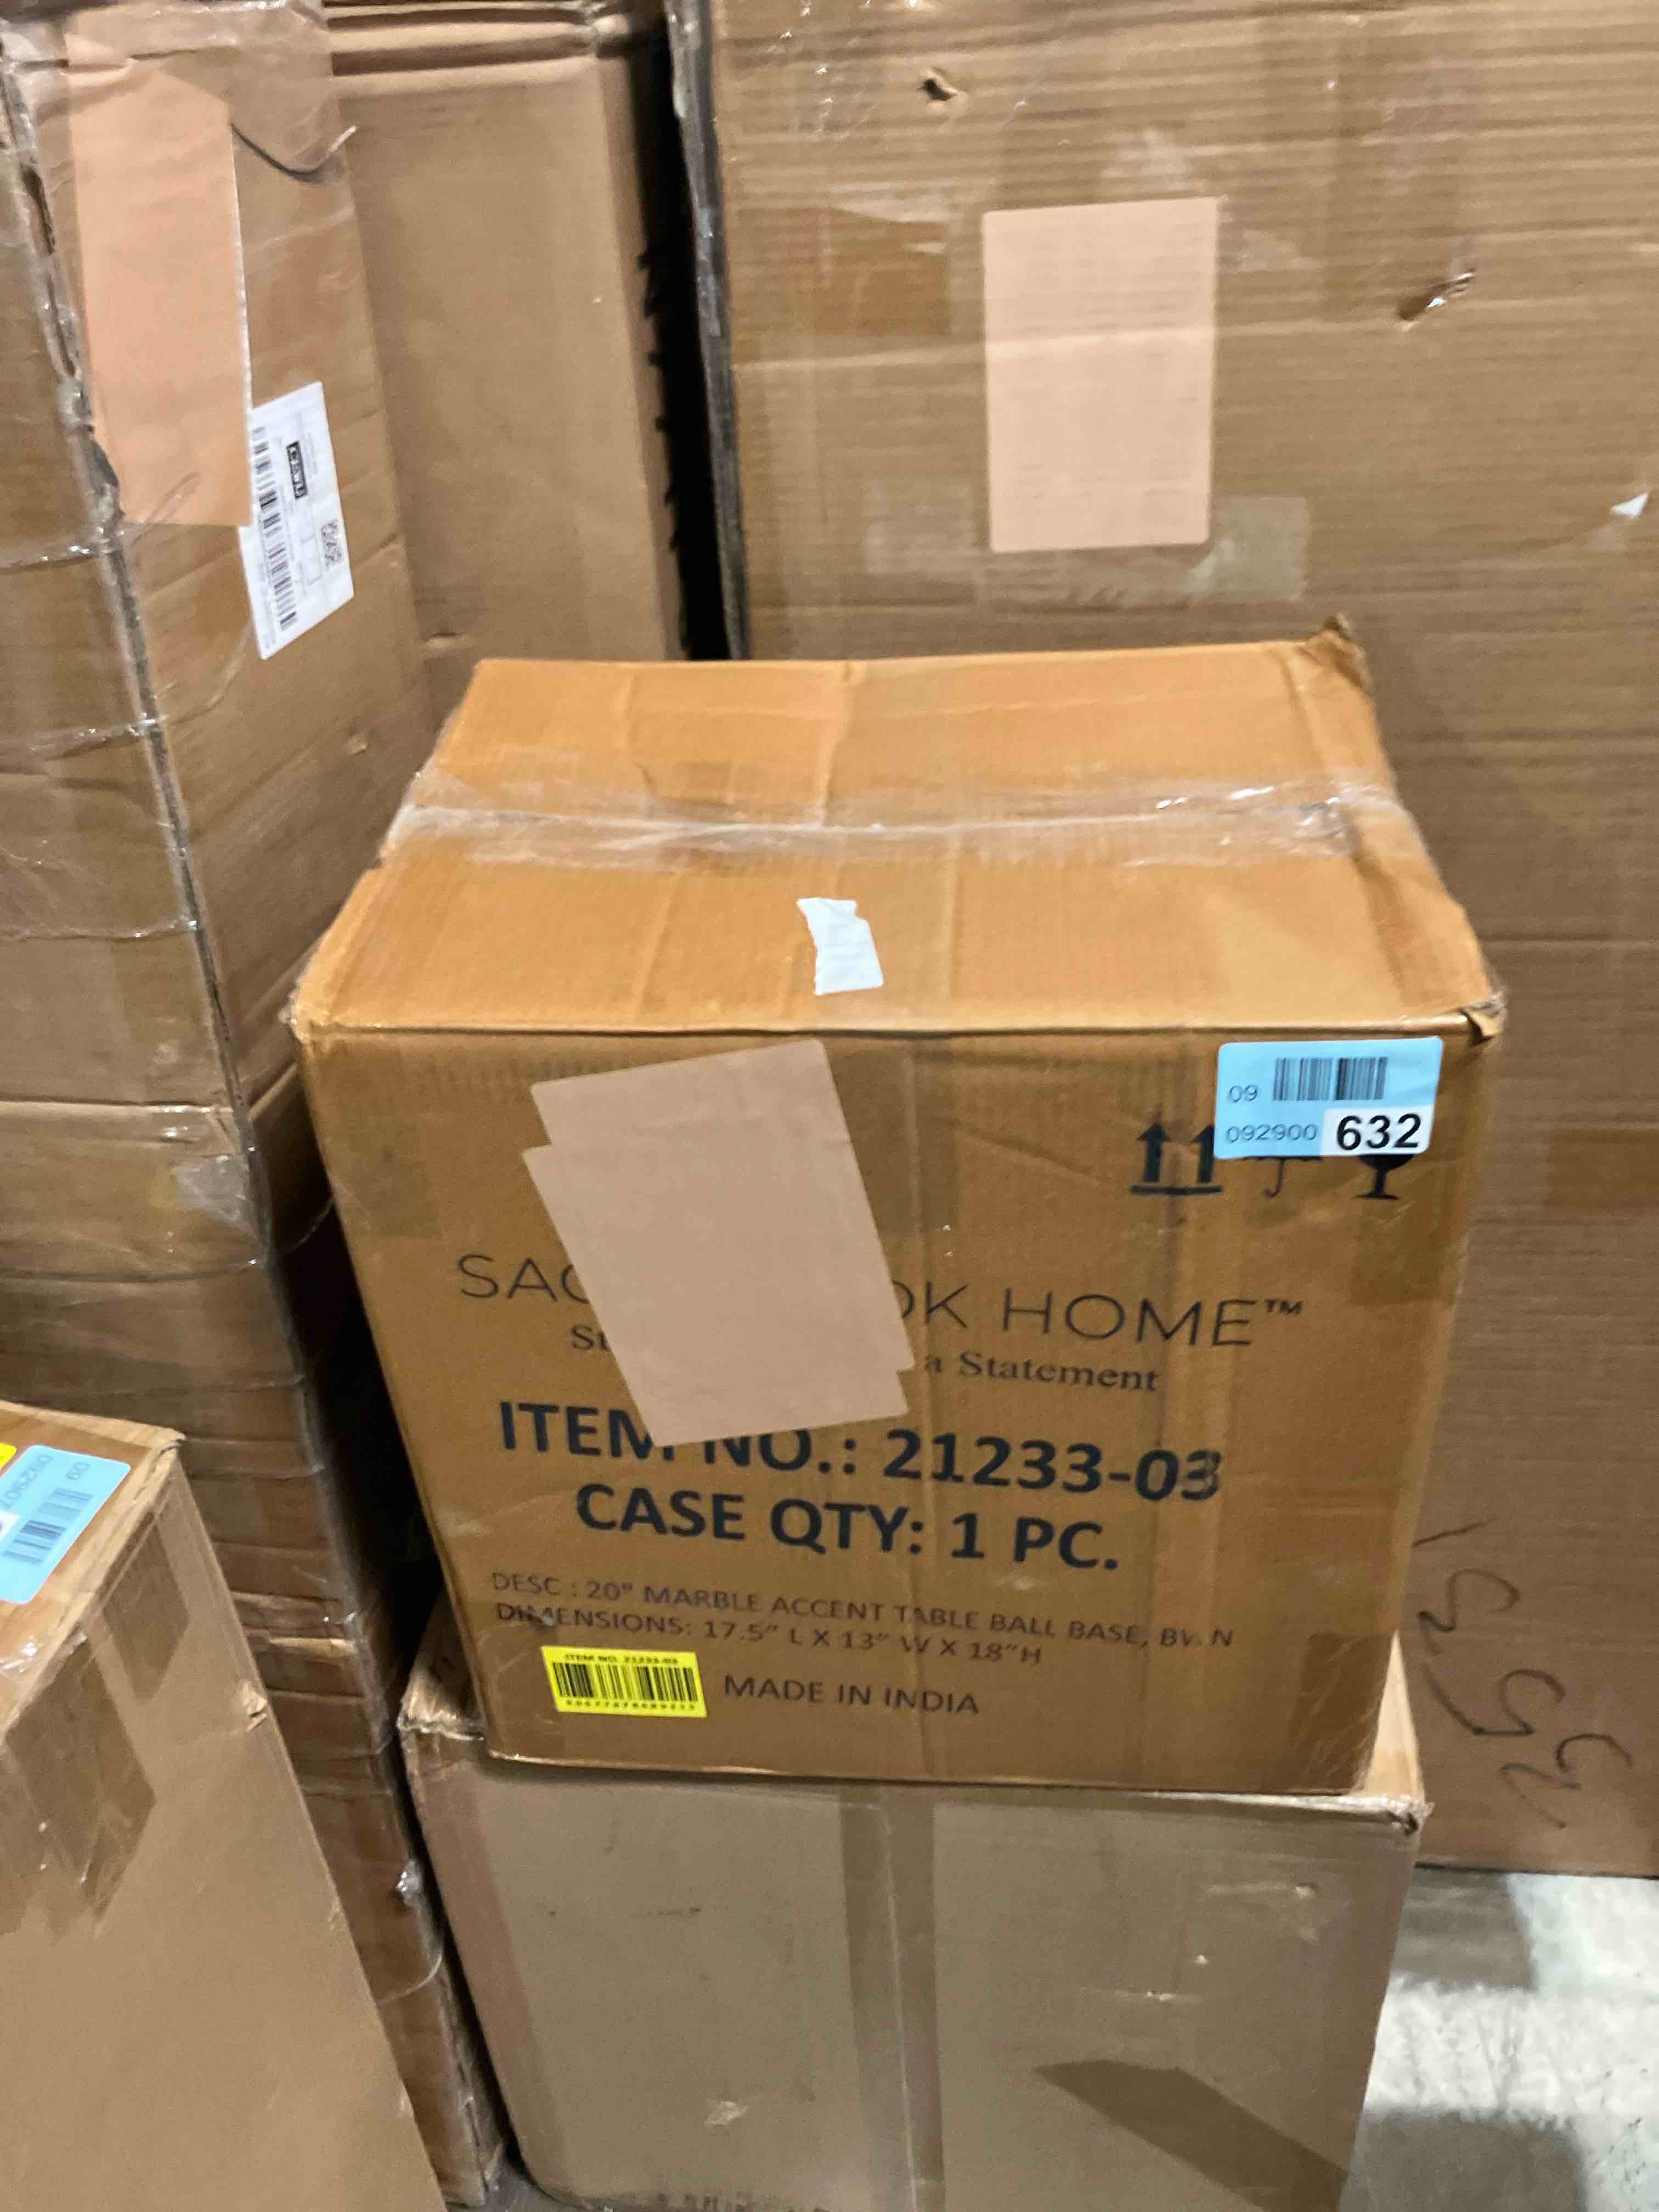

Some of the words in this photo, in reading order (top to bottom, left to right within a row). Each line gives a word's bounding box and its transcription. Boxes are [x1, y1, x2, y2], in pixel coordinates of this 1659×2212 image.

[1227, 1084, 1258, 1103] 09
[1224, 1122, 1318, 1143] 092900
[1336, 1113, 1421, 1150] 632
[924, 1353, 943, 1373] a
[960, 1350, 1159, 1392] Statement
[499, 1401, 674, 1462] ITEM
[883, 1427, 1223, 1502] 21233-03
[575, 1483, 746, 1540] CASE
[770, 1498, 923, 1555] QTY:
[950, 1511, 985, 1559] 1
[1013, 1516, 1118, 1570] PC.
[643, 1585, 763, 1612] MARBLE
[771, 1596, 883, 1622] ACCENT
[894, 1605, 980, 1629] TABLE
[990, 1613, 1056, 1638] BALL
[1068, 1620, 1148, 1648] BASE,
[789, 1628, 804, 1645] L
[812, 1628, 831, 1647] X
[900, 1635, 932, 1654] W
[939, 1638, 957, 1656] X
[724, 1674, 824, 1703] MADE
[838, 1684, 871, 1706] IN
[885, 1687, 979, 1714] INDIA
